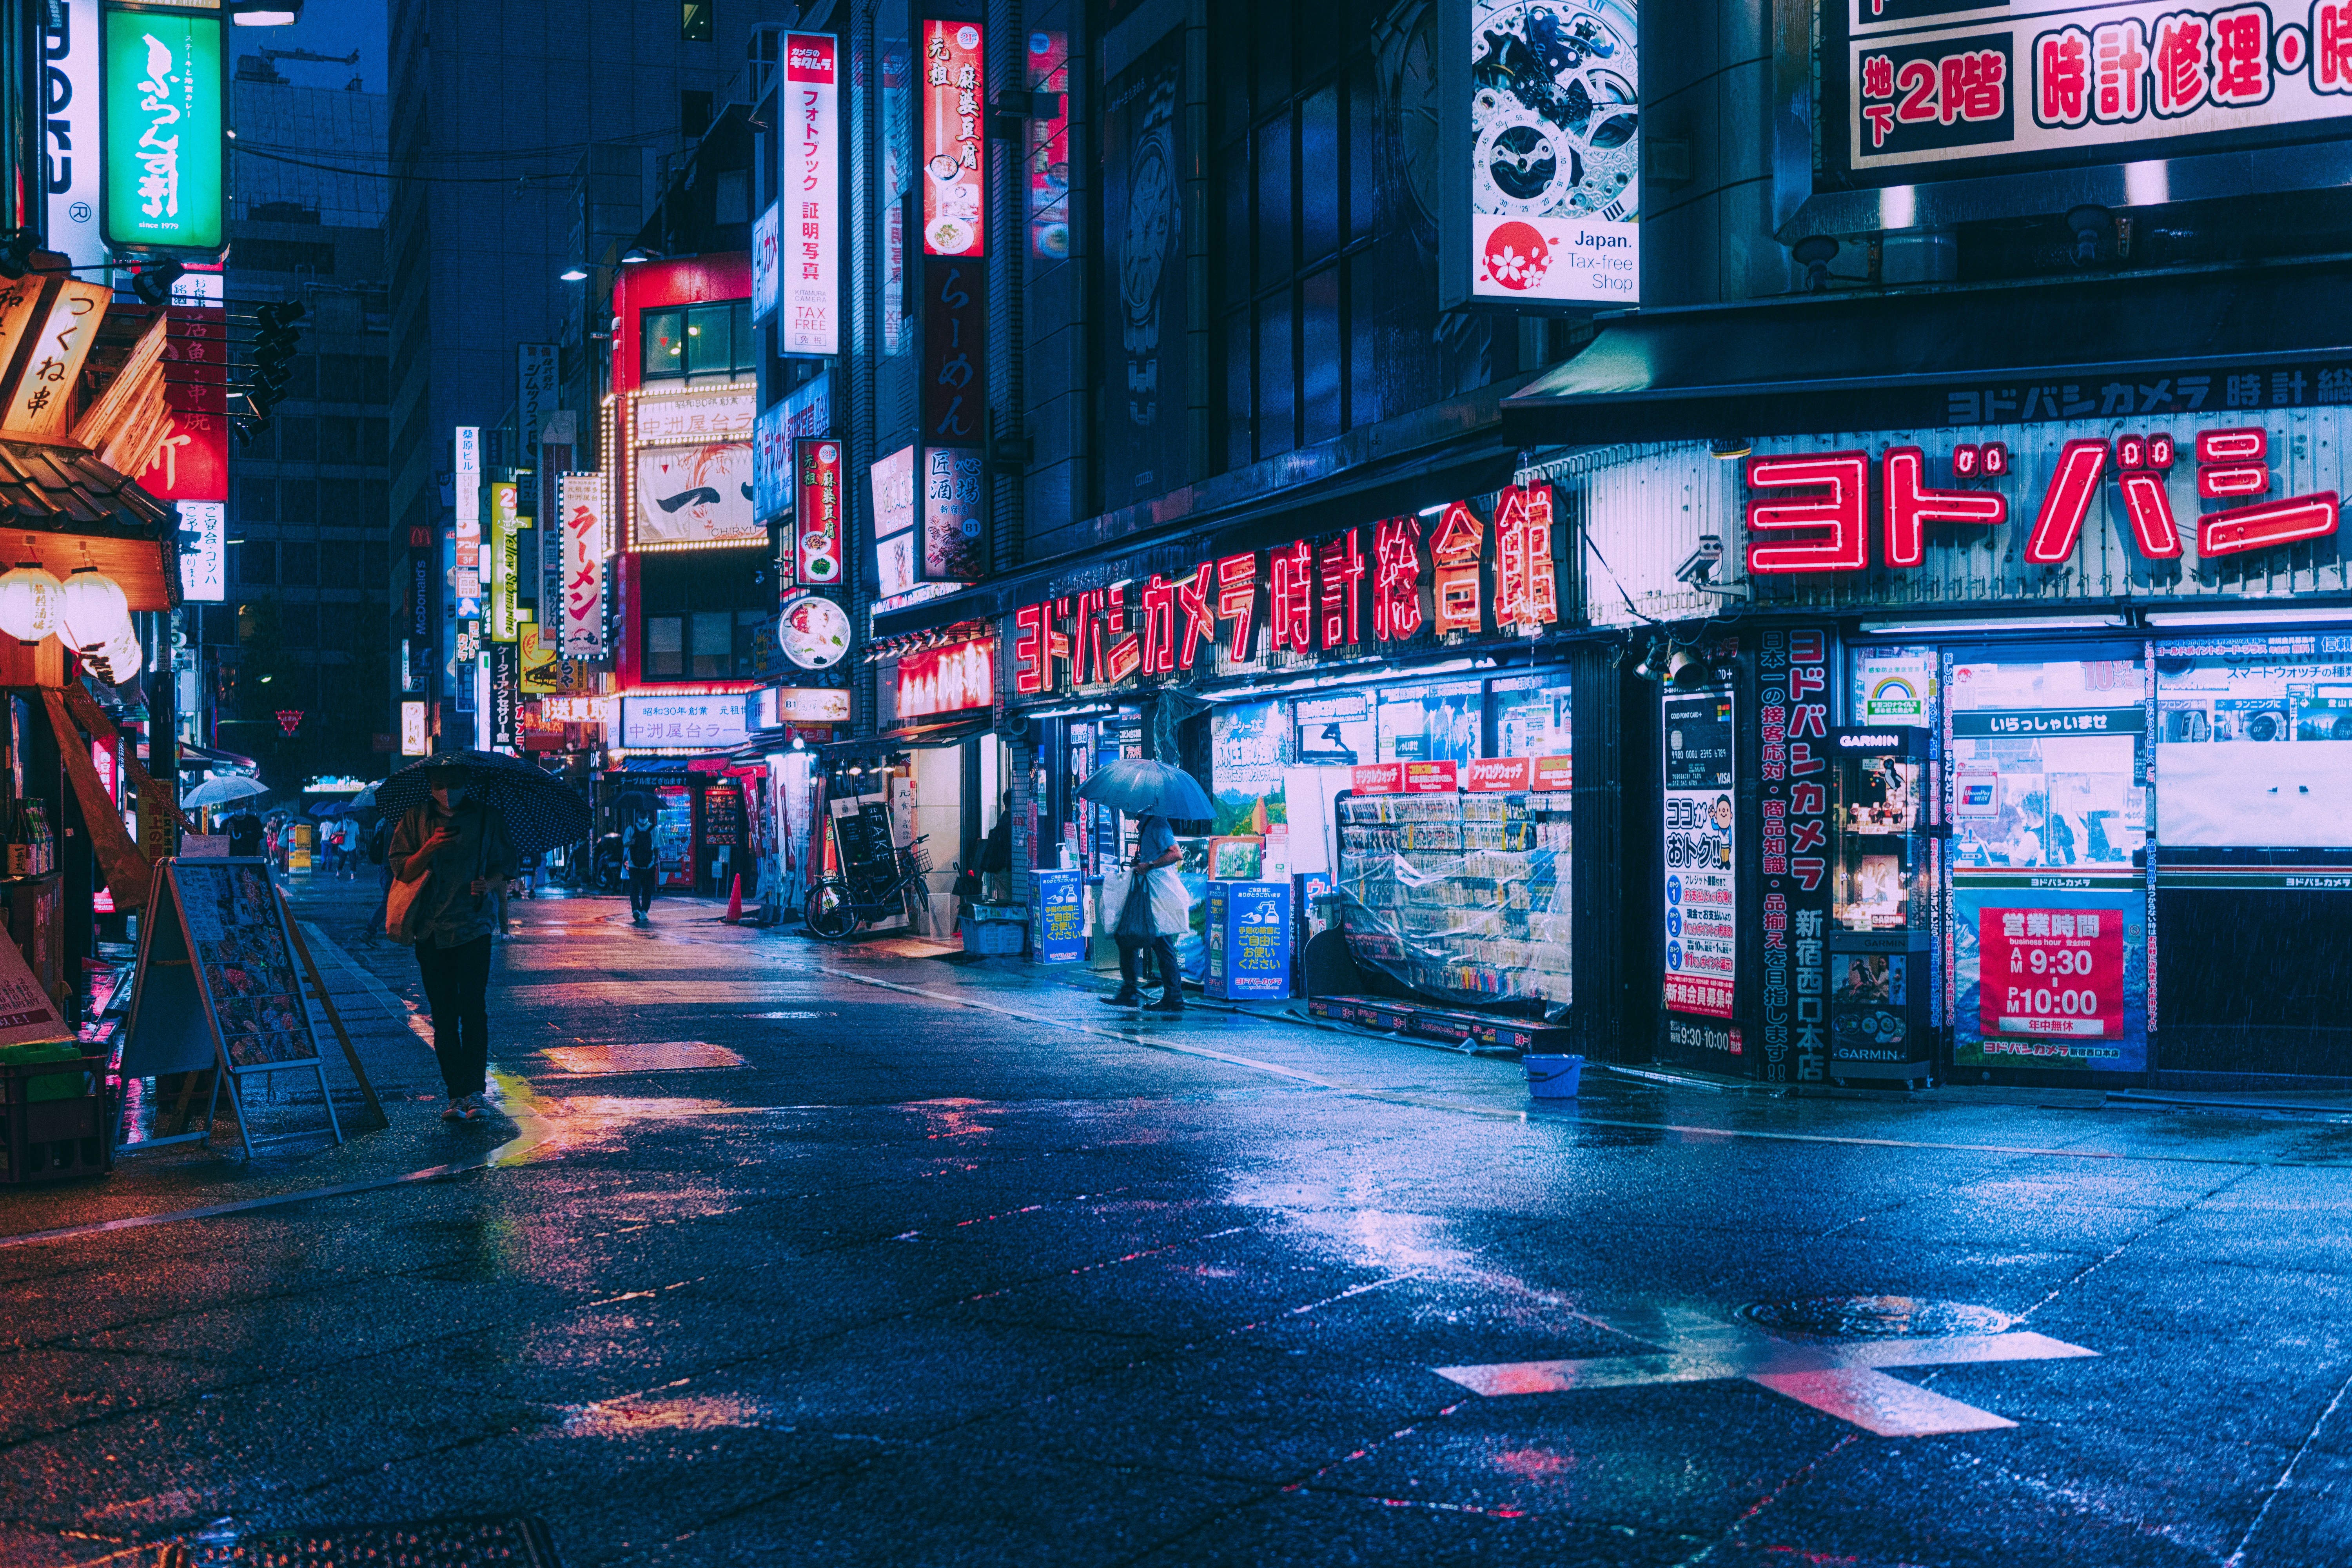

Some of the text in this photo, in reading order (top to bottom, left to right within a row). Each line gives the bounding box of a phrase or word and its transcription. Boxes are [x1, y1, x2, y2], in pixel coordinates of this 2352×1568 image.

[960, 33, 977, 44] 2F
[791, 47, 820, 57] カメラの
[928, 37, 951, 86] 元祖
[955, 63, 980, 171] 麻婆豆腐
[1536, 118, 1544, 127] 60
[1495, 120, 1504, 129] 50
[802, 91, 819, 280] フォトブック 証明写真
[138, 221, 179, 230] since 1979
[1575, 230, 1632, 249] Japan.
[1567, 252, 1633, 271] Tax-free
[1592, 274, 1633, 293] Shop
[796, 307, 826, 319] TAX
[795, 319, 826, 330] FREE
[800, 335, 822, 344] 免税
[937, 268, 975, 435] らーめん
[27, 297, 94, 419] つくね串
[675, 396, 739, 408] 昭和30年創業
[817, 392, 828, 418] TAX
[463, 429, 473, 470] 桑原ビル
[822, 450, 835, 459] 2F
[803, 454, 818, 486] 元祖
[1135, 472, 1153, 487] CITIZEN
[930, 477, 980, 505] 酒場
[820, 470, 837, 539] 麻婆豆腐
[1746, 426, 2339, 575] ヨドバシ
[940, 505, 968, 515] 新宿店
[708, 525, 757, 537] ICHIRYU
[965, 524, 979, 532] B1
[463, 556, 474, 564] 3F
[568, 505, 598, 621] ラーメン
[505, 532, 517, 634] Yellow Submarine
[416, 560, 426, 635] McDonald's
[546, 577, 557, 628] 讃岐うどん
[469, 621, 479, 659] ヨドバシ
[457, 634, 468, 662] カメラ
[497, 646, 510, 742] ケータイアクセサリー館
[643, 706, 708, 717] 昭和30年創業
[1991, 714, 2107, 731] いらっしゃいませ
[1840, 735, 1898, 747] GARMIN
[1943, 652, 1953, 824] 新しい価値ある商品をどんどん安く
[1671, 749, 1726, 759] 4980 0001 2345 6789
[1355, 766, 1397, 784] デジタルウォッチ
[1474, 763, 1523, 780] アナログウォッチ
[621, 777, 686, 785] テーブル席ございます!
[1717, 772, 1731, 784] VISA
[1964, 787, 1991, 796] UnionPay
[1667, 798, 1707, 829] ココが
[1788, 630, 1827, 1081] ヨドバシカメラ 新宿西口本店
[2031, 879, 2091, 887] ヨドバシカメラ
[2285, 878, 2351, 887] ヨドバシカメラ
[1671, 889, 1677, 900] 1
[1046, 912, 1080, 922] ご自由に
[1872, 915, 1904, 924] GARMIN
[1050, 922, 1076, 931] お使い
[1671, 920, 1677, 931] 2
[2002, 913, 2099, 938] 営業時間
[1047, 931, 1081, 941] ください
[1238, 935, 1280, 946] ご自由に
[1864, 939, 1906, 947] GARMIN
[1243, 947, 1275, 958] お使い
[1238, 958, 1281, 970] ください
[1671, 955, 1677, 965] 3
[2010, 947, 2092, 975] AM 9:30
[1666, 981, 1733, 1011] 新規会員募集中
[2007, 986, 2097, 1015] PM 10:00
[2029, 1020, 2074, 1031] 年中無休
[1515, 1032, 1531, 1049] 日本一!
[1838, 1048, 1898, 1060] GARMIN
[1984, 1042, 2120, 1058] ヨドバシカメラ 新宿西口本店
